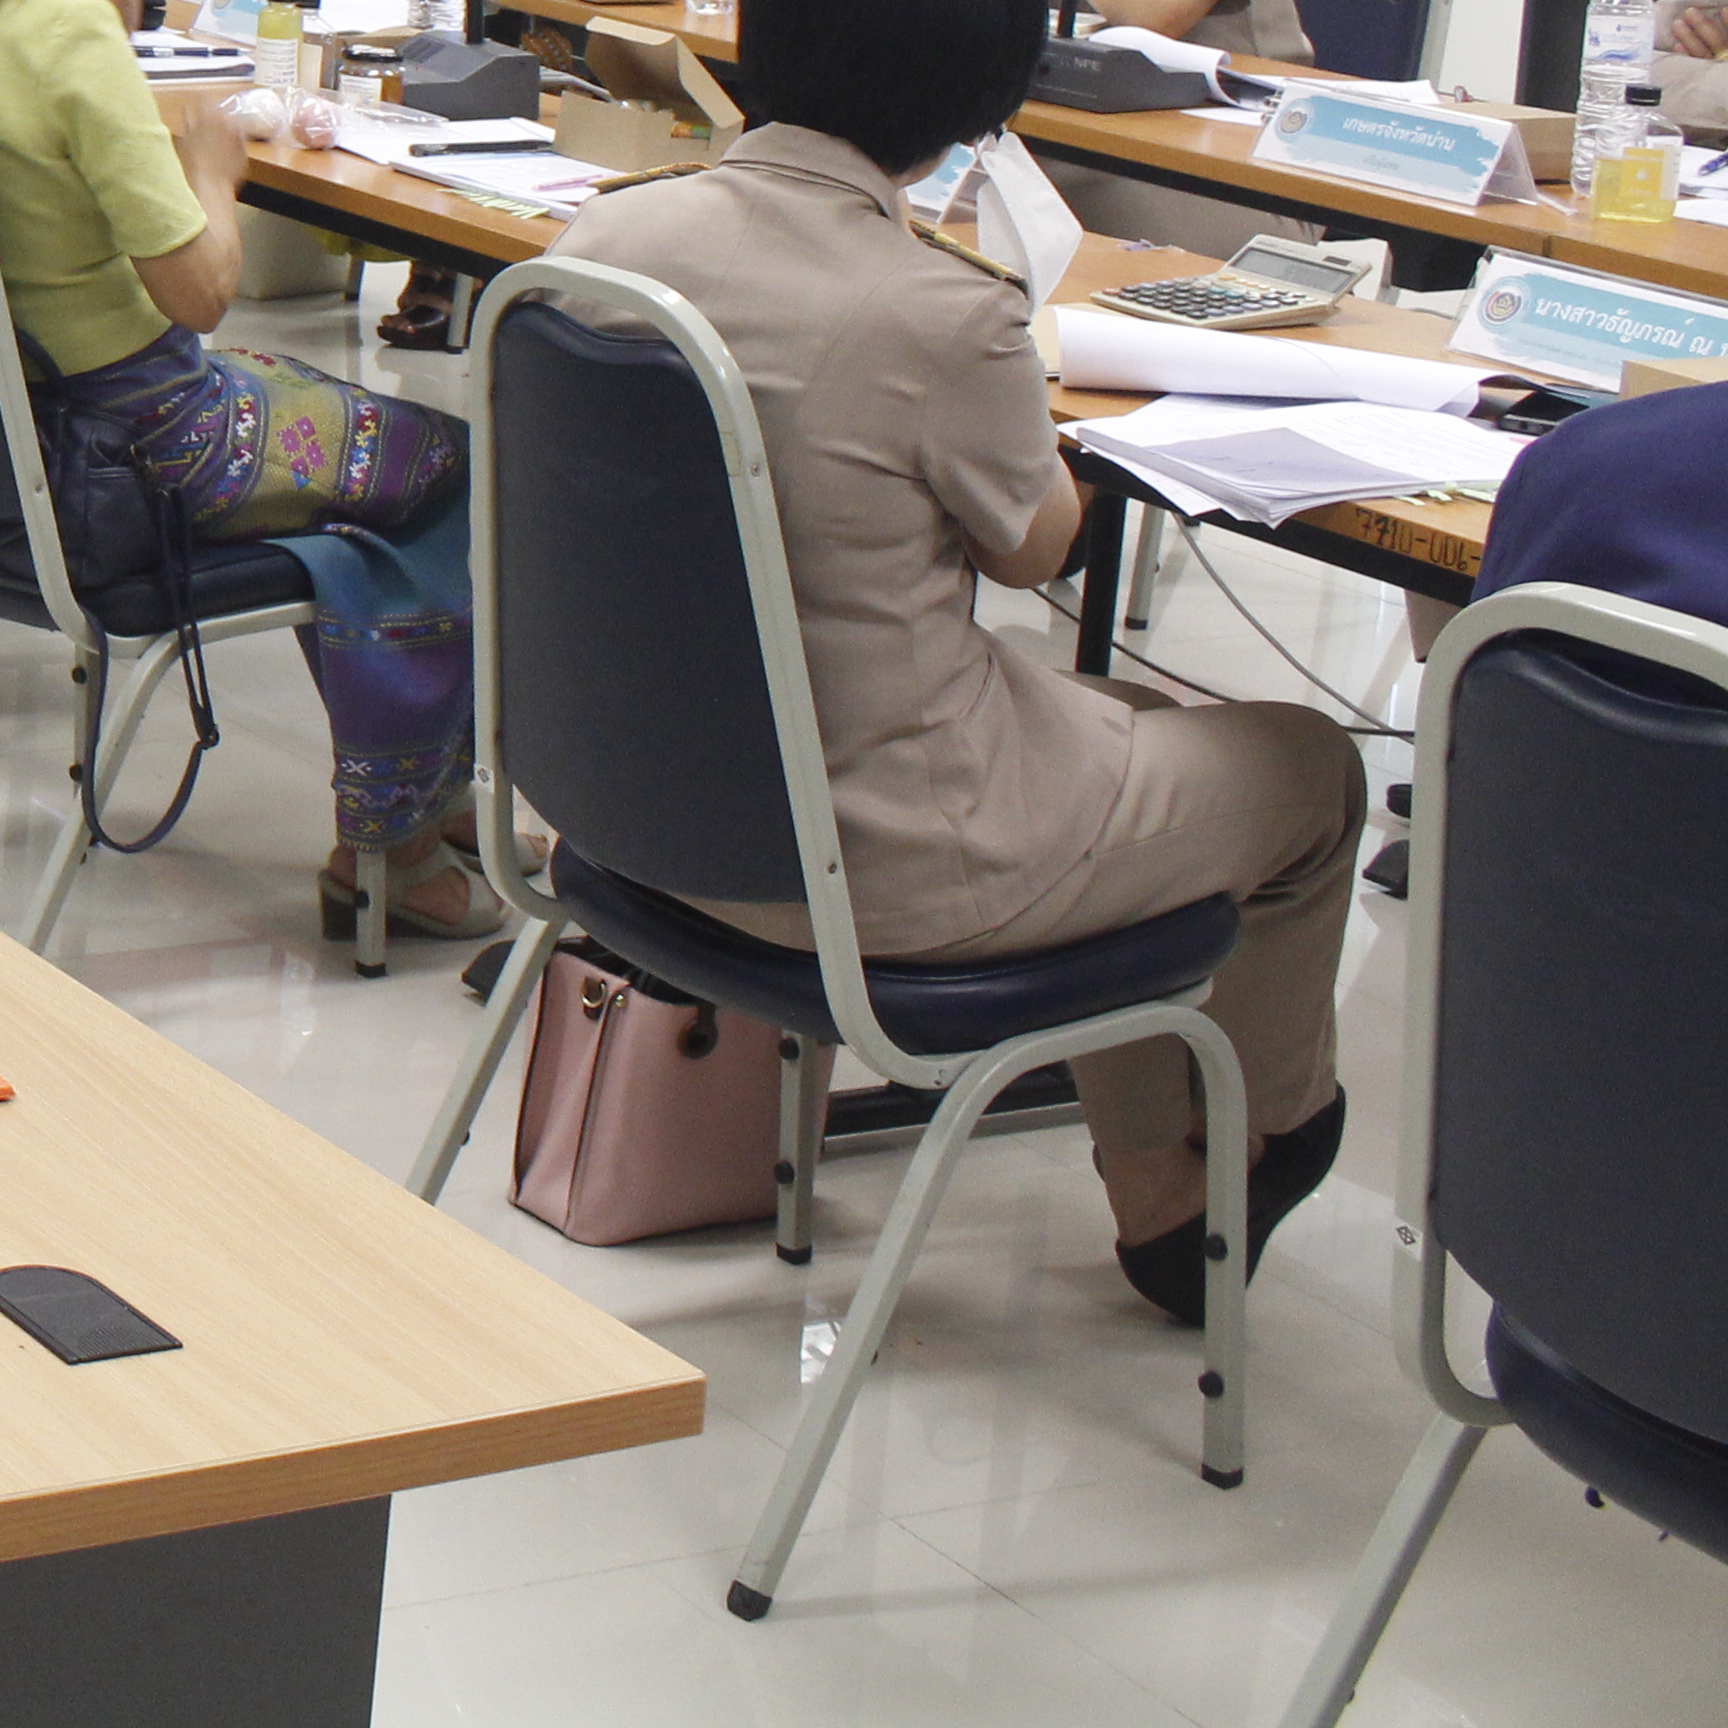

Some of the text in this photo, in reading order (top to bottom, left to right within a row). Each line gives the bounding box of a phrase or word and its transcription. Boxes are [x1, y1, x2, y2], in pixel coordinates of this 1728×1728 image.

[1074, 57, 1100, 71] NPE
[1343, 117, 1456, 152] เกษตรจังหวัดน่าน
[1535, 295, 1714, 357] นางสาวธัญภรณ์ ณ
